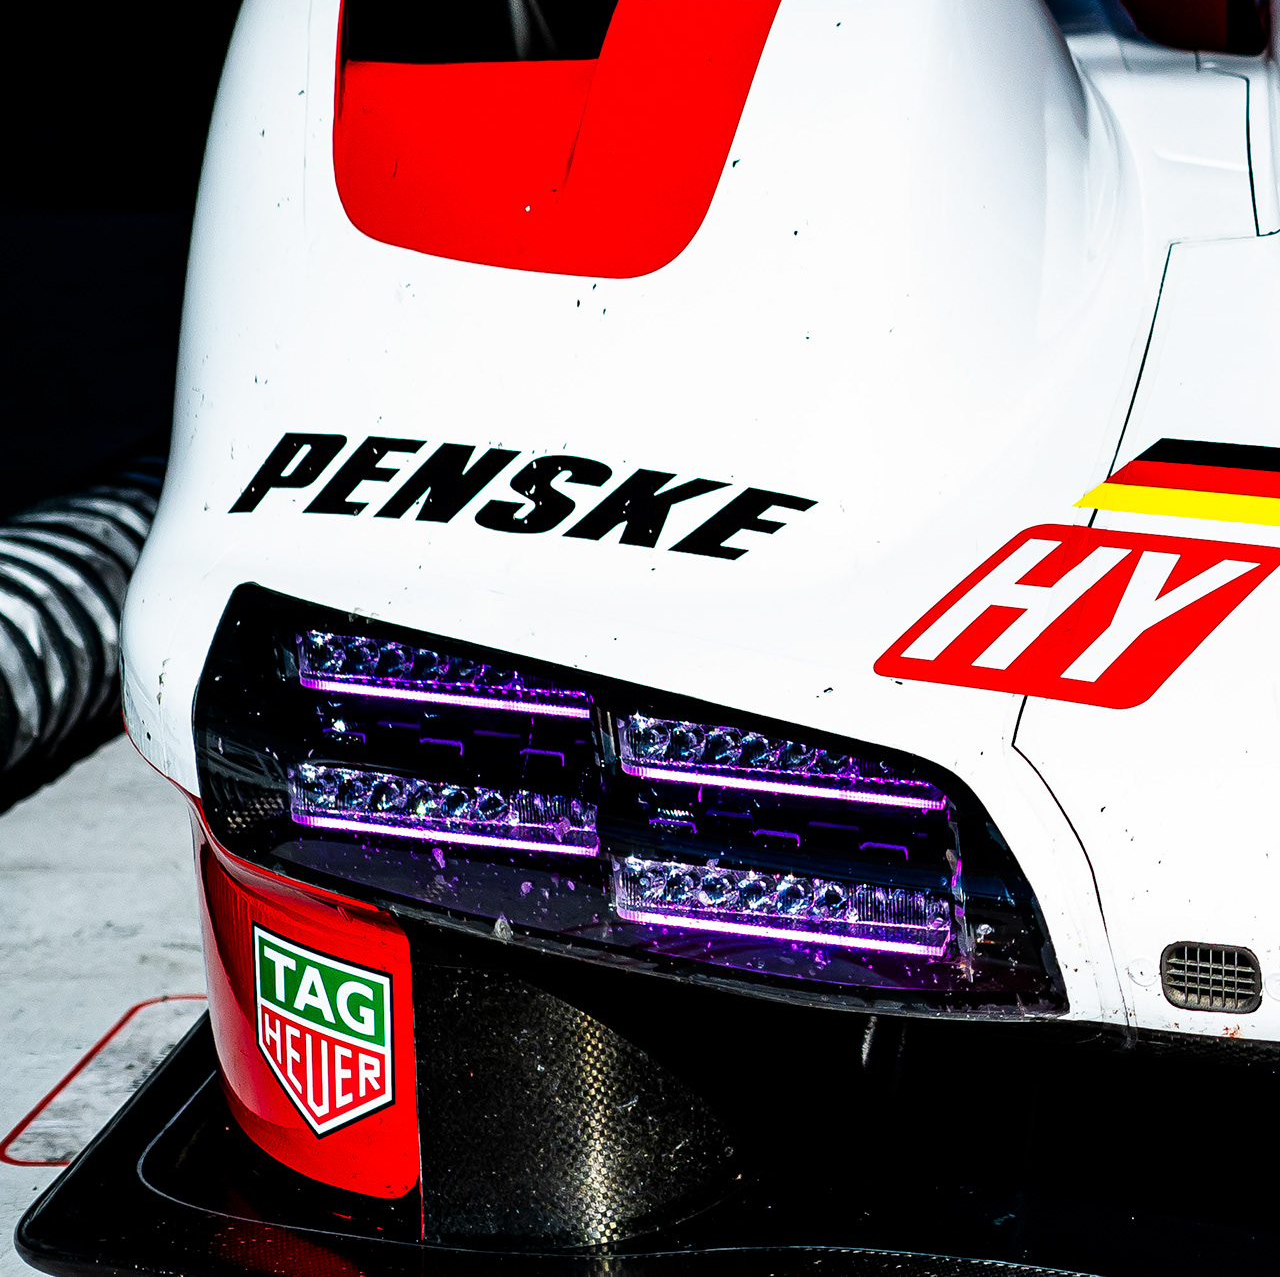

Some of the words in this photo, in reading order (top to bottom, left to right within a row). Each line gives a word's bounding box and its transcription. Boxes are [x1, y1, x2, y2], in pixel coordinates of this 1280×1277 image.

[227, 431, 820, 561] PENSKE
[900, 537, 1264, 683] HY
[263, 945, 376, 1037] TAG
[264, 1012, 381, 1118] HEUER
